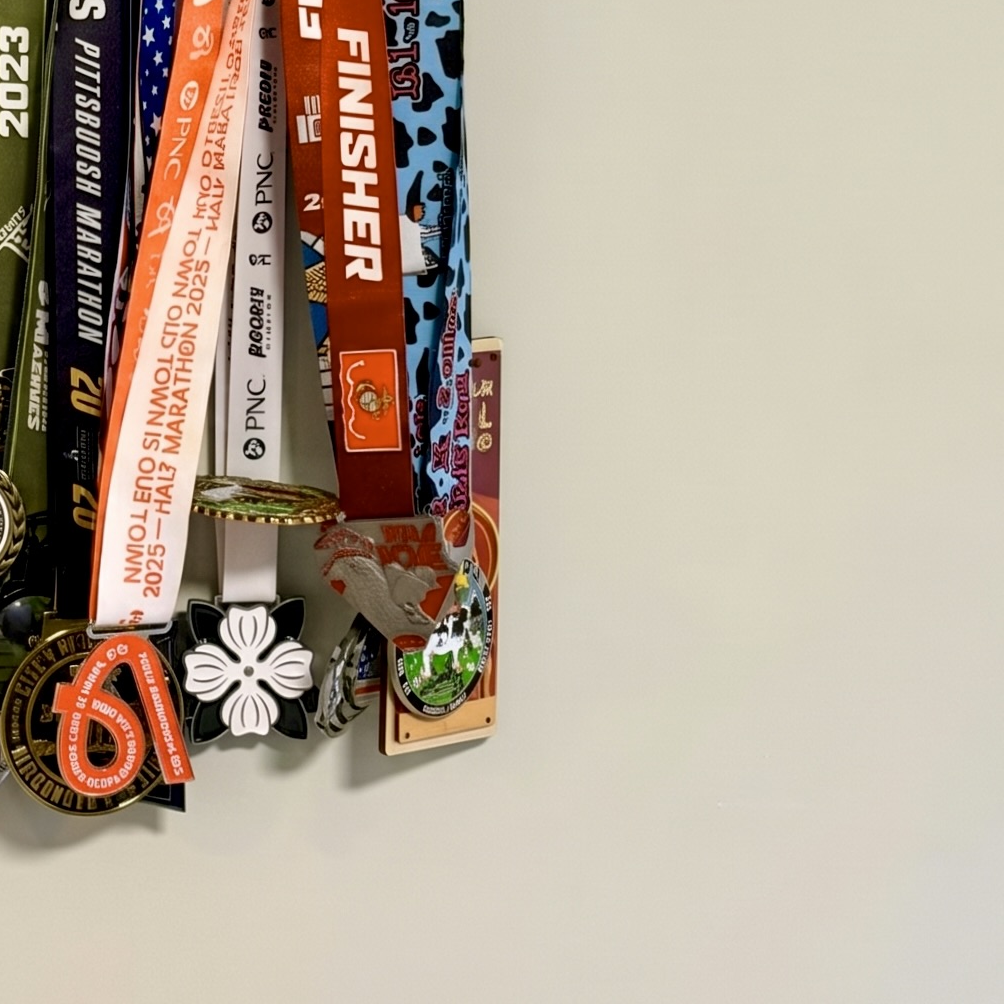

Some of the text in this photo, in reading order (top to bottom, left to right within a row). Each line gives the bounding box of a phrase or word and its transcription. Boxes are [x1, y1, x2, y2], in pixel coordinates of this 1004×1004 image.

[254, 151, 275, 207] PNC
[337, 27, 384, 283] FINISHER
[74, 201, 104, 347] MARATHON
[142, 542, 166, 598] 2025
[161, 322, 199, 456] MARATHON
[186, 259, 211, 317] 2025
[244, 377, 267, 433] PNC
